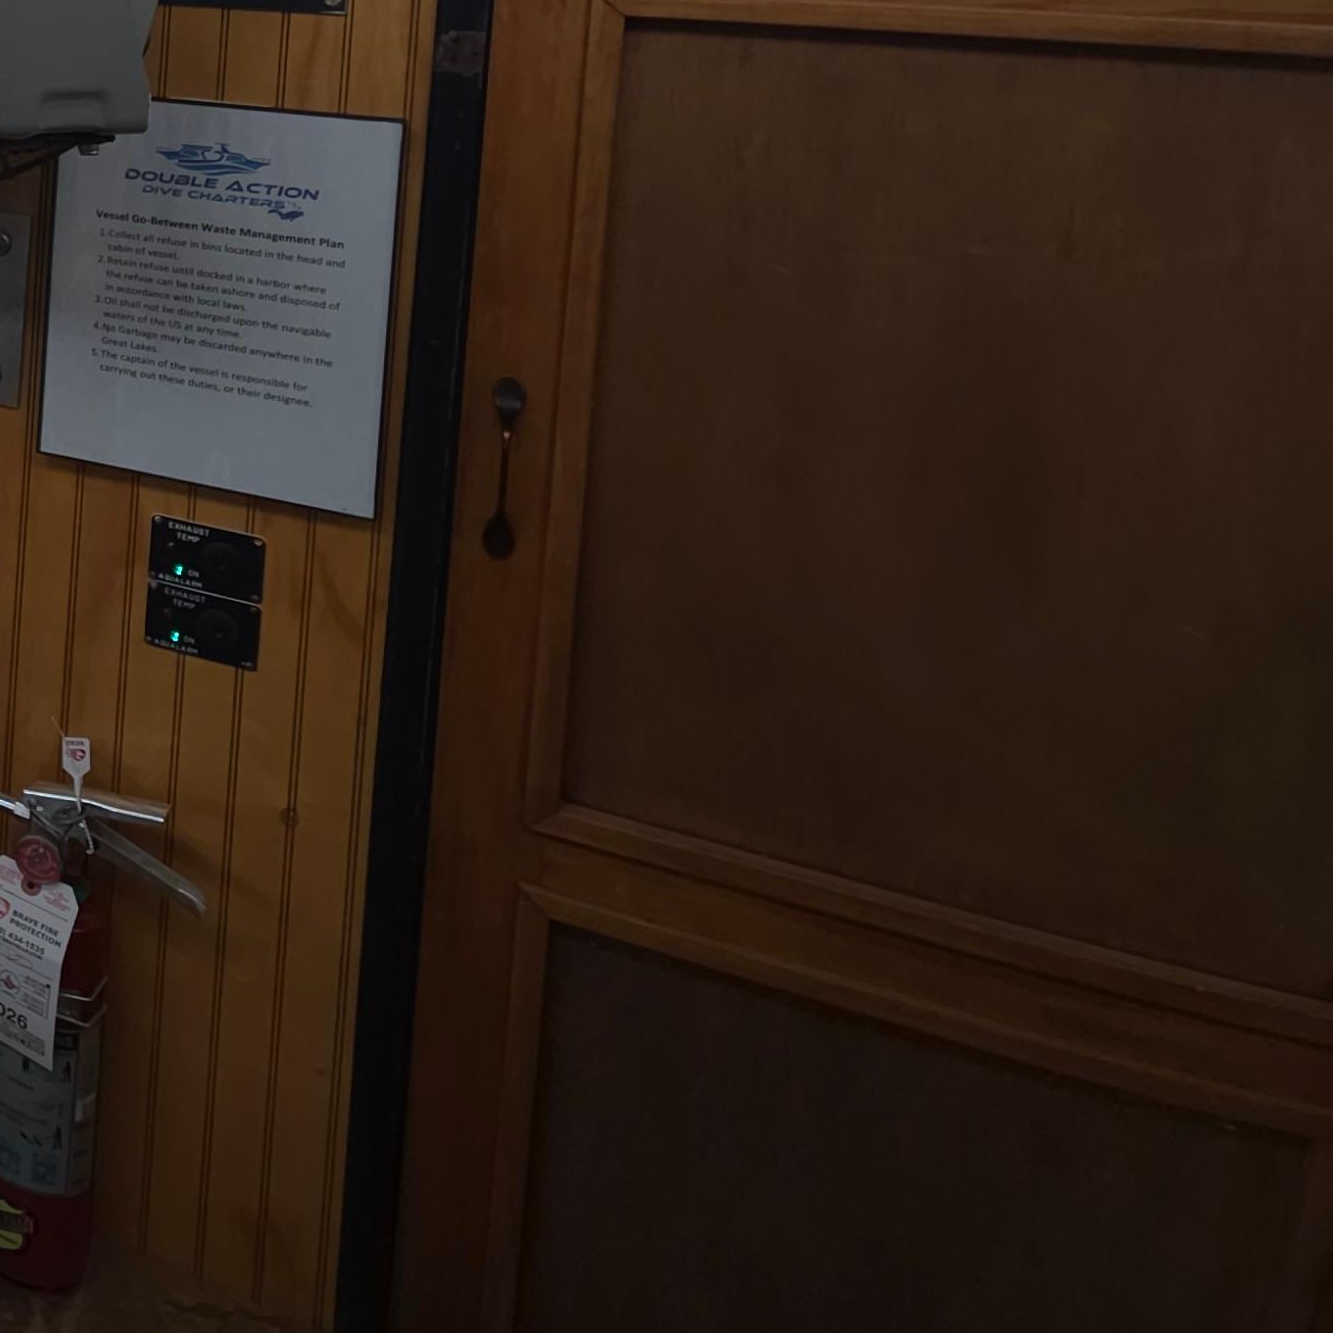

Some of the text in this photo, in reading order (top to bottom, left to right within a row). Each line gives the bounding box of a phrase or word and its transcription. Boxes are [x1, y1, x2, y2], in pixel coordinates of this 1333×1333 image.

[124, 168, 320, 201] DOUBLE ACTION
[142, 184, 286, 210] DIVE CHARTERS
[95, 209, 345, 249] Vessel Go-Between Waste Management Plan
[107, 242, 180, 260] cabin of vessel.
[108, 229, 140, 241] Collect
[142, 233, 155, 243] all
[156, 235, 187, 248] refuse
[189, 239, 199, 249] in
[201, 241, 222, 252] bins
[223, 244, 262, 258] located
[263, 249, 274, 259] in
[276, 251, 294, 262] the
[296, 254, 323, 266] head
[325, 257, 346, 269] and
[105, 269, 340, 311] the refuse can be taken ashore and disposed of
[106, 255, 137, 268] Retain
[138, 260, 170, 273] refuse
[171, 264, 195, 276] until
[196, 268, 233, 282] docked
[234, 273, 245, 283] in
[246, 275, 254, 284] a
[255, 276, 291, 290] harbor
[292, 281, 326, 295] where
[104, 283, 247, 312] in accordance with local laws.
[102, 309, 241, 339] waters of the US at any time.
[103, 295, 117, 306] Oil
[119, 297, 141, 310] shall
[142, 301, 159, 312] not
[161, 304, 174, 315] be
[176, 306, 230, 324] discharged
[232, 315, 260, 329] upon
[260, 319, 279, 331] the
[281, 322, 332, 339] navigable
[100, 336, 159, 353] Great Lakes.
[102, 322, 116, 333] No
[117, 325, 158, 341] Garbage
[159, 332, 182, 344] may
[183, 335, 196, 346] be
[197, 338, 247, 354] discarded
[248, 346, 300, 363] anywhere
[302, 354, 314, 365] in
[314, 356, 333, 368] the
[100, 349, 118, 360] The
[119, 352, 155, 367] captain
[156, 358, 168, 368] of
[170, 361, 186, 371] the
[187, 364, 219, 377] vessel
[220, 369, 229, 379] is
[230, 371, 291, 390] responsible
[292, 381, 308, 392] for
[99, 363, 313, 409] carrying out these duties, or their designee.
[168, 521, 210, 538] EXHAUST
[176, 531, 201, 543] TEMP
[164, 586, 205, 604] EXHAUST
[173, 597, 196, 609] TEMP
[10, 918, 61, 948] PROTECTION
[13, 910, 59, 938] BRAVE FIRE
